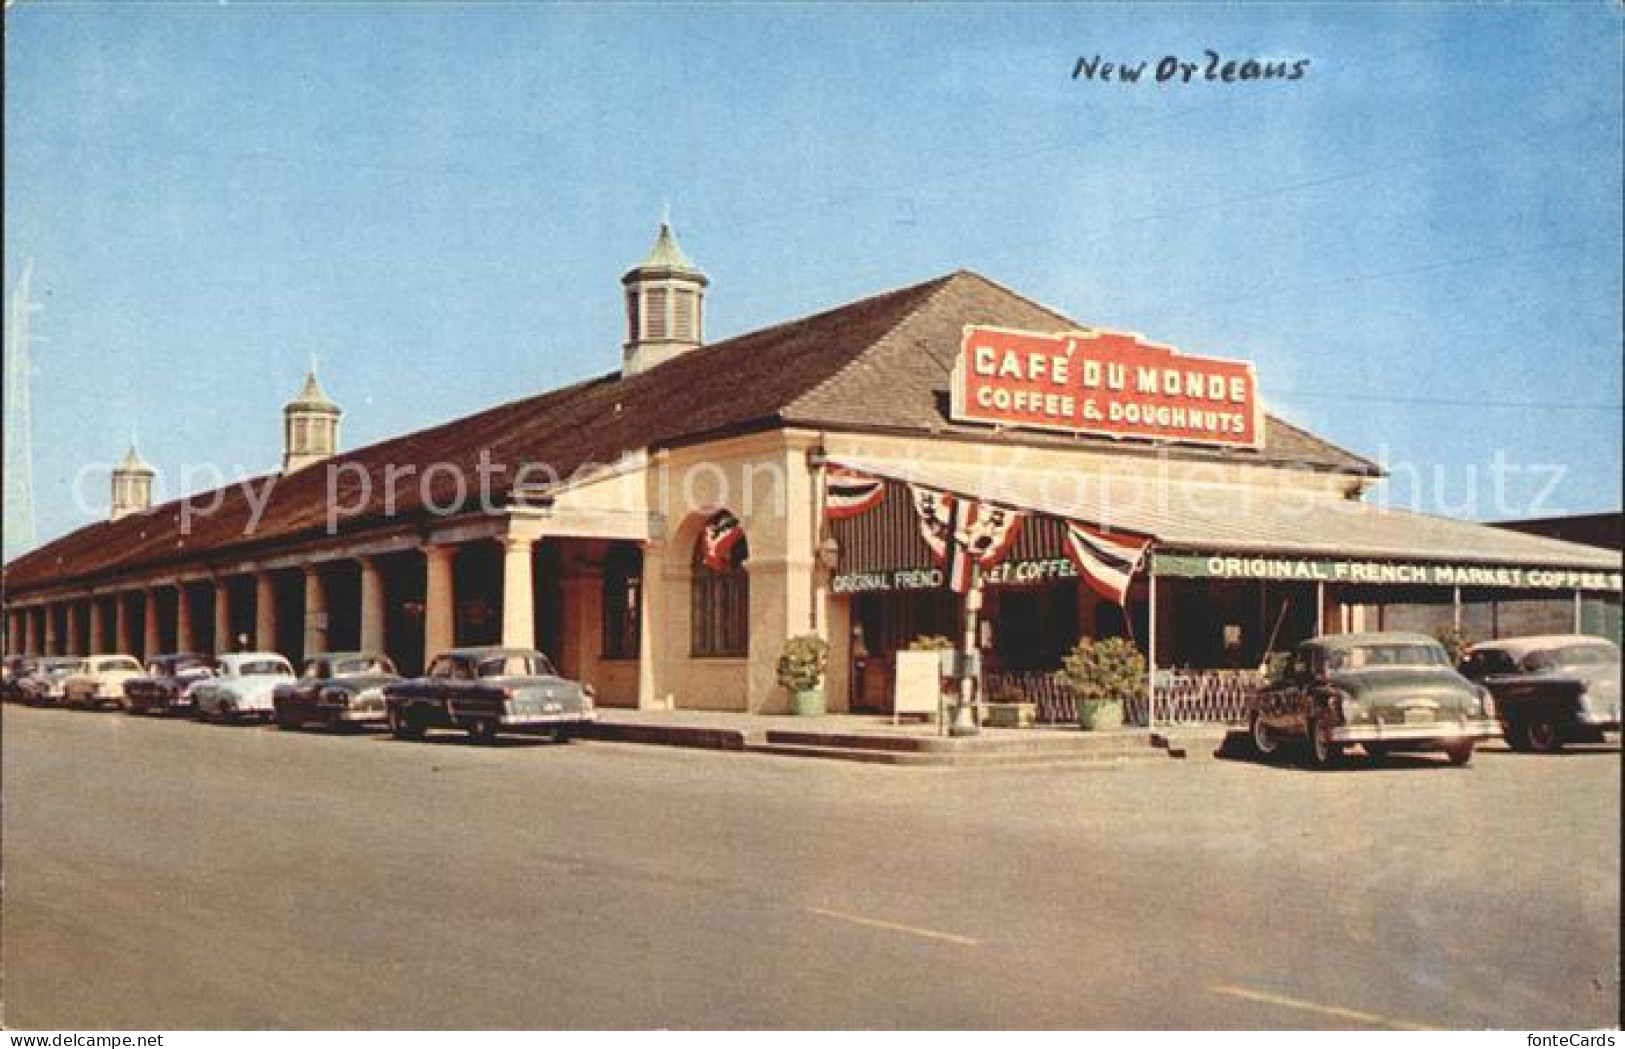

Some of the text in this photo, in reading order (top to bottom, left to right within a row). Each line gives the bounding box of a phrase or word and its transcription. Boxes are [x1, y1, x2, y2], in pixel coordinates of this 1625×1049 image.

[1072, 49, 1311, 83] New Orleans
[1082, 360, 1125, 390] DU
[1136, 365, 1245, 402] MONDE
[976, 386, 1245, 433] COFFEE & DOUGHNUTS
[895, 569, 943, 588] FRENC
[1208, 557, 1328, 580] ORIGINAL
[1335, 562, 1427, 583] FRENCH
[1434, 566, 1522, 585] MARKET
